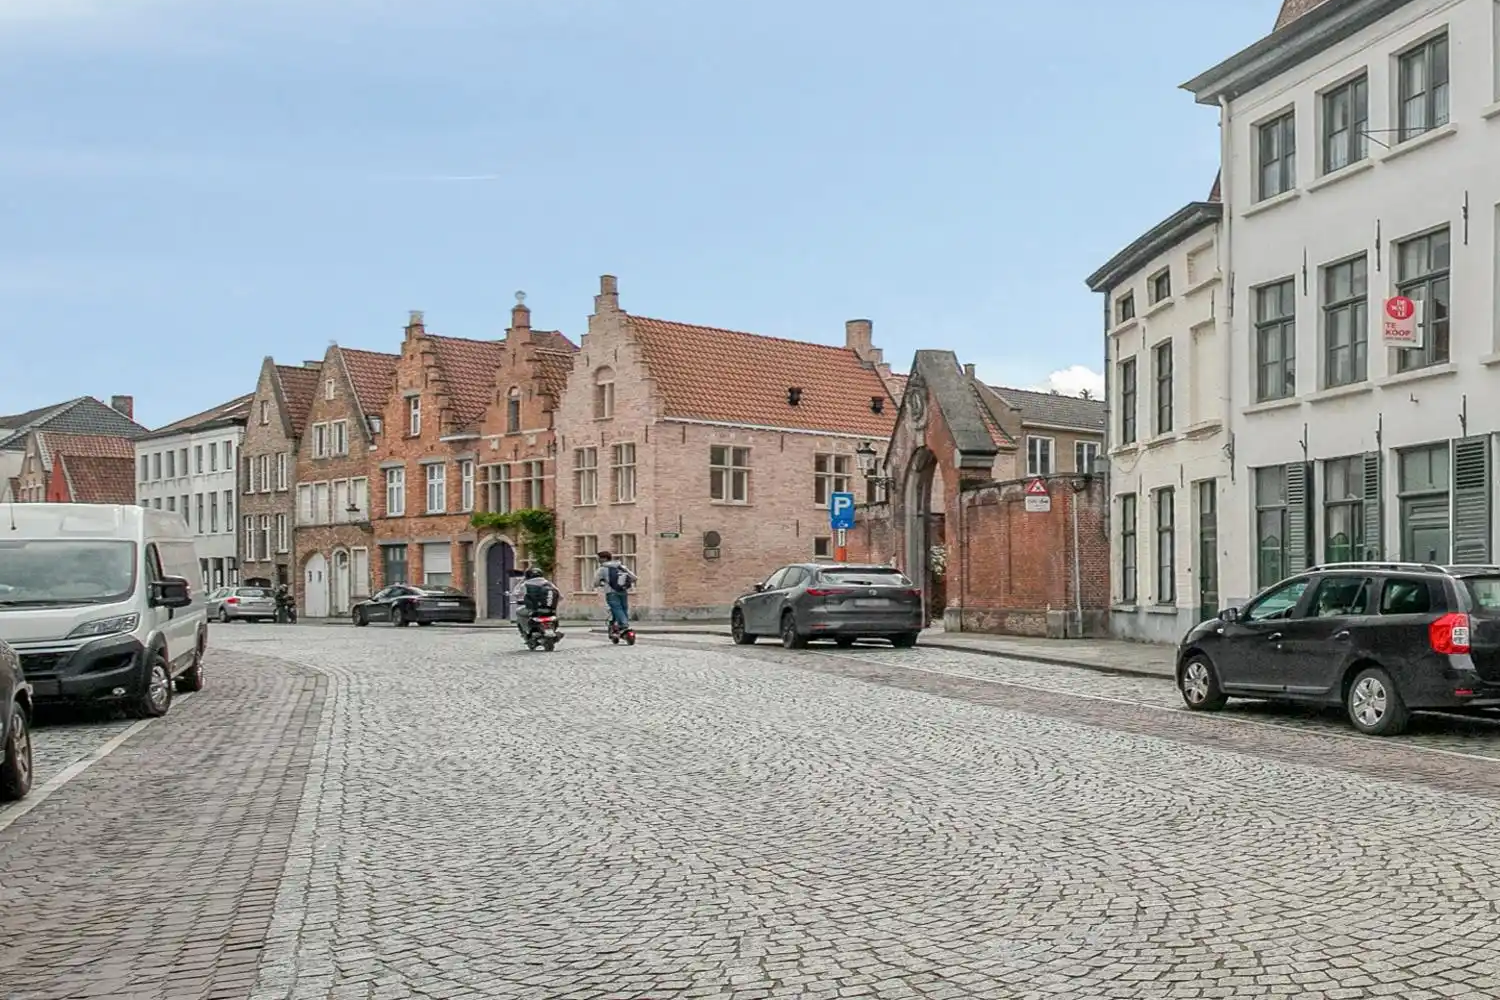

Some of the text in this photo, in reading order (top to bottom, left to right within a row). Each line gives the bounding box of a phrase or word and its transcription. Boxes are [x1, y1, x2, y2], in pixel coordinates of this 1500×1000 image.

[1385, 321, 1396, 329] TE
[1385, 329, 1411, 337] KOOP
[834, 496, 851, 516] P
